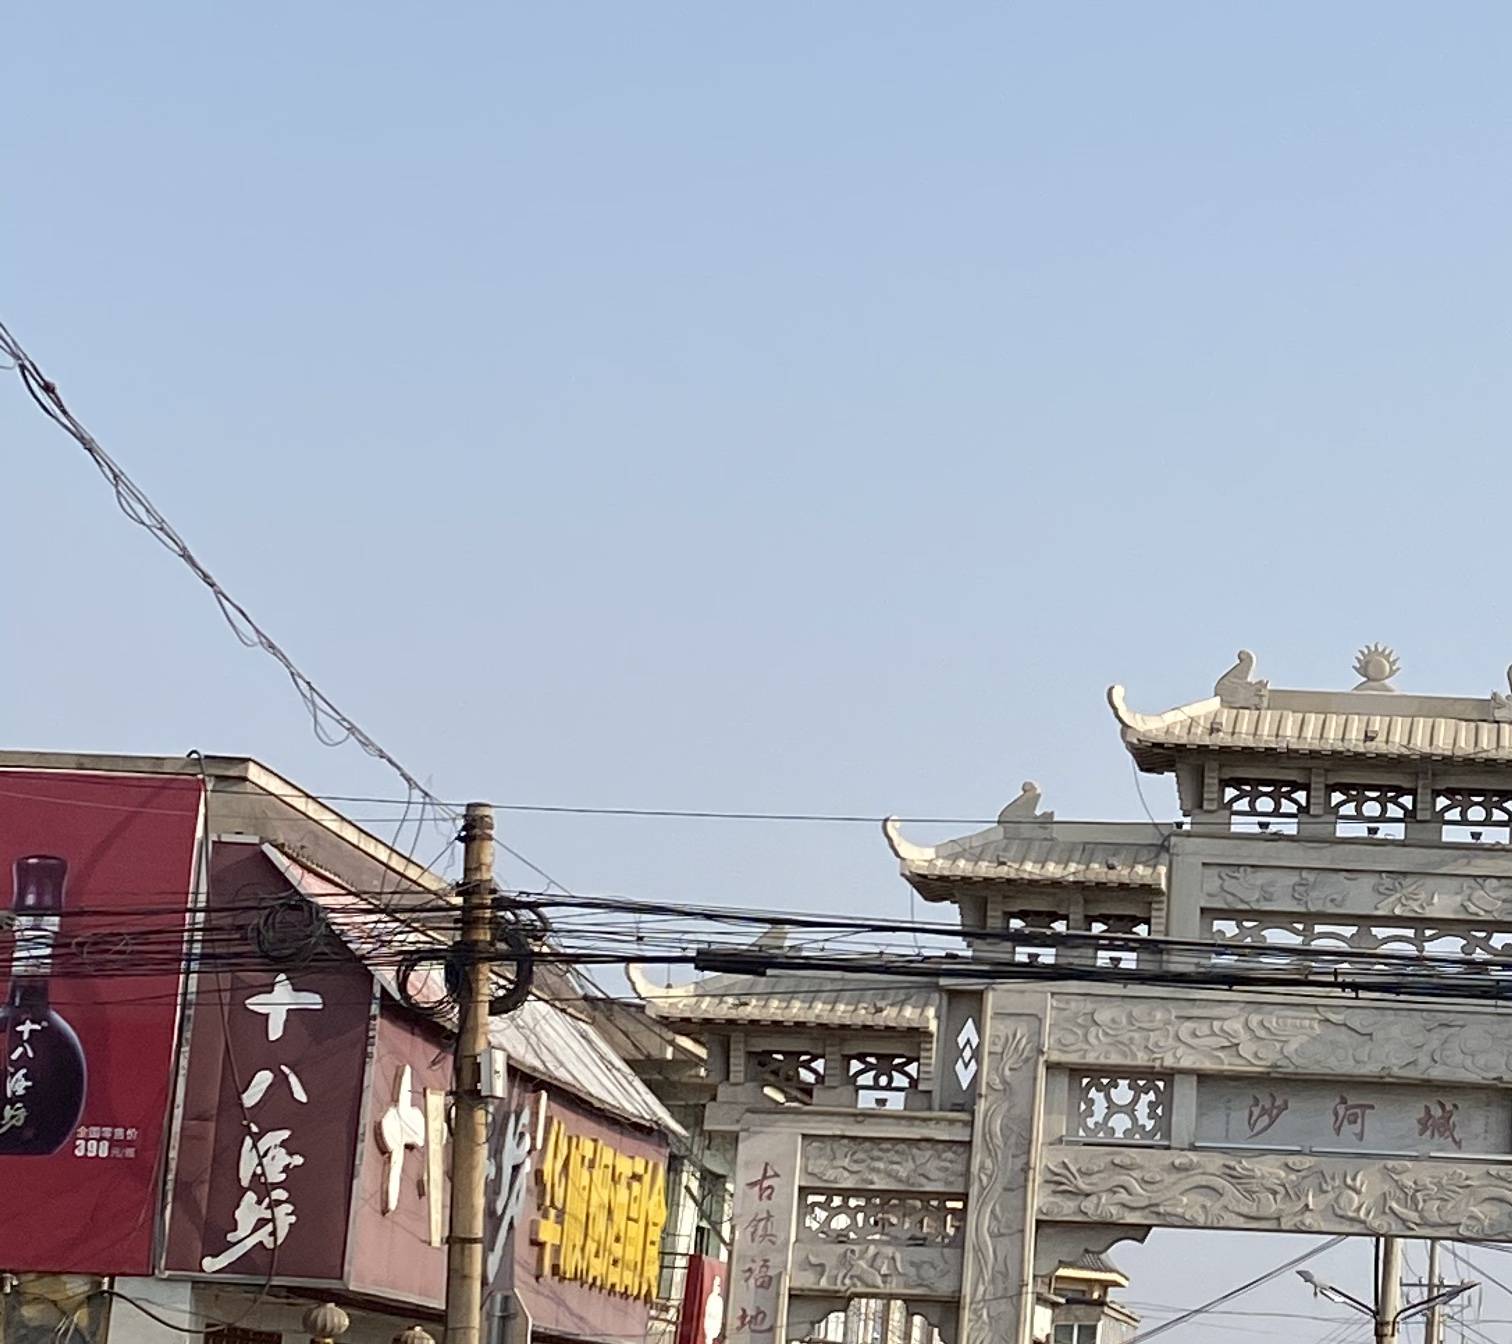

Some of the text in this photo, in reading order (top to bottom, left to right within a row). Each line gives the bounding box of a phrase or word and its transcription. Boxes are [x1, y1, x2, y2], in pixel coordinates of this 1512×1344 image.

[201, 972, 324, 1273] 十八酒坊
[1246, 1092, 1462, 1150] 沙河城
